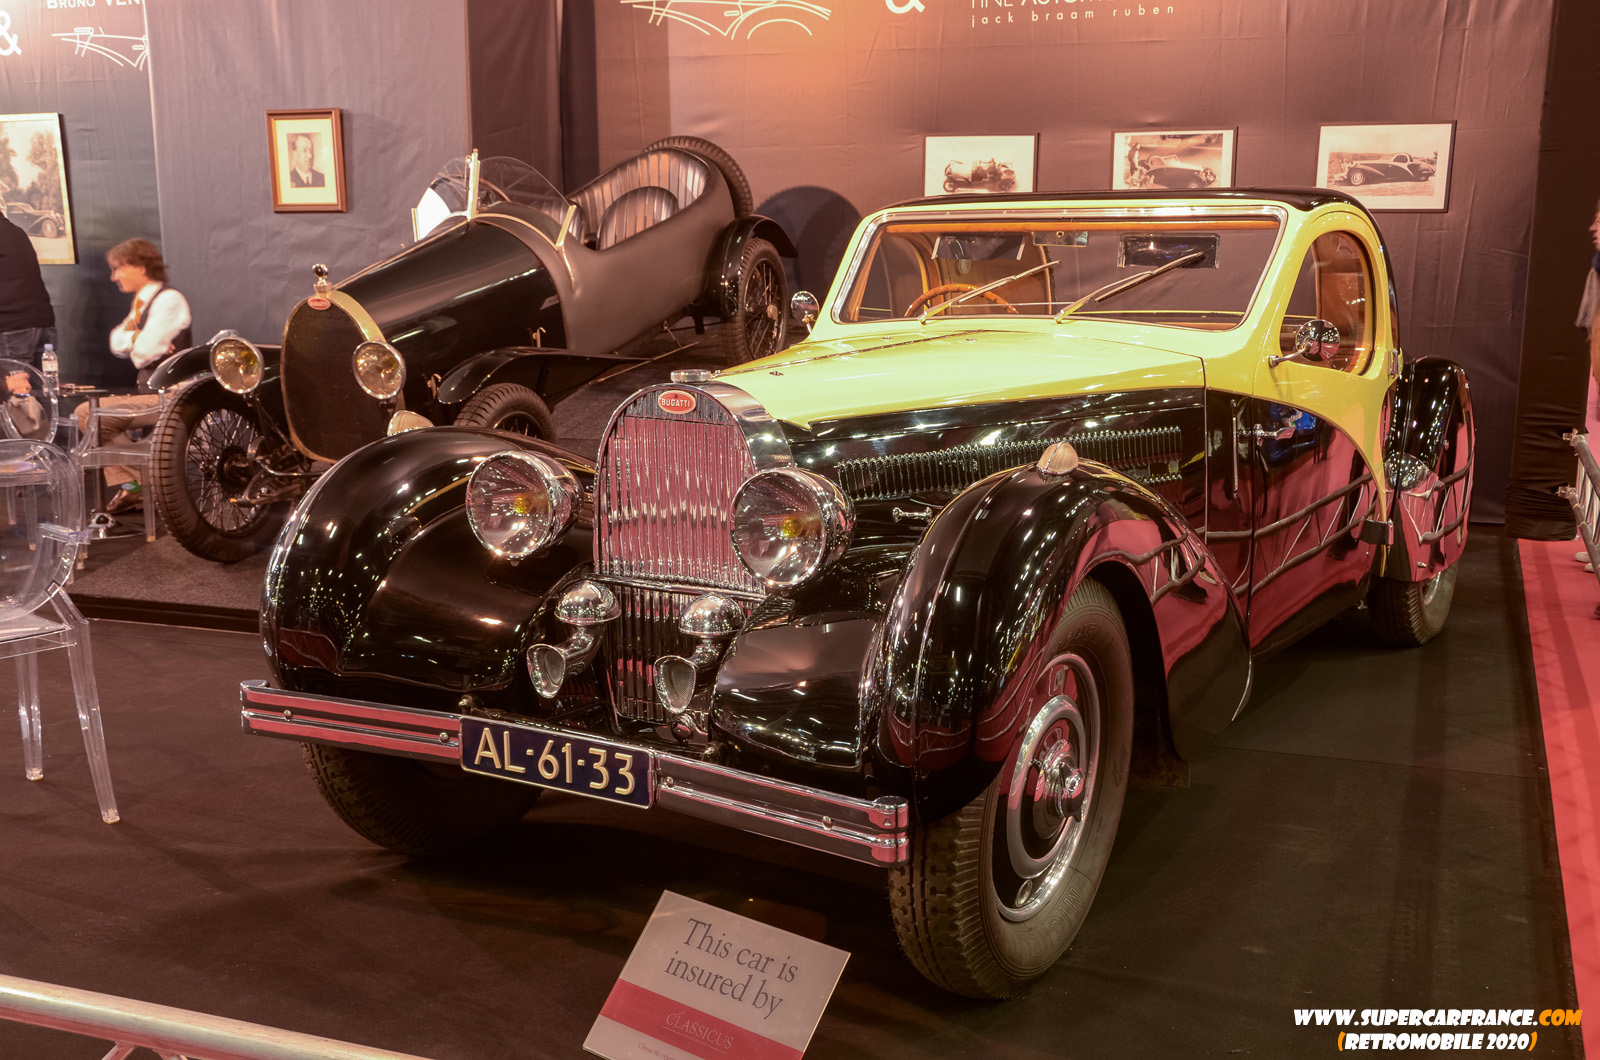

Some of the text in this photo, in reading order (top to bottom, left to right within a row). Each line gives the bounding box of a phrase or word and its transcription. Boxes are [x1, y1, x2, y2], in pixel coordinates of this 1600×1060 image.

[971, 4, 1174, 28] jack braam ruben
[661, 398, 691, 408] BUGATTI
[683, 917, 799, 983] This car is
[664, 950, 784, 1020] insured by
[666, 1012, 734, 1049] CLASSICUS
